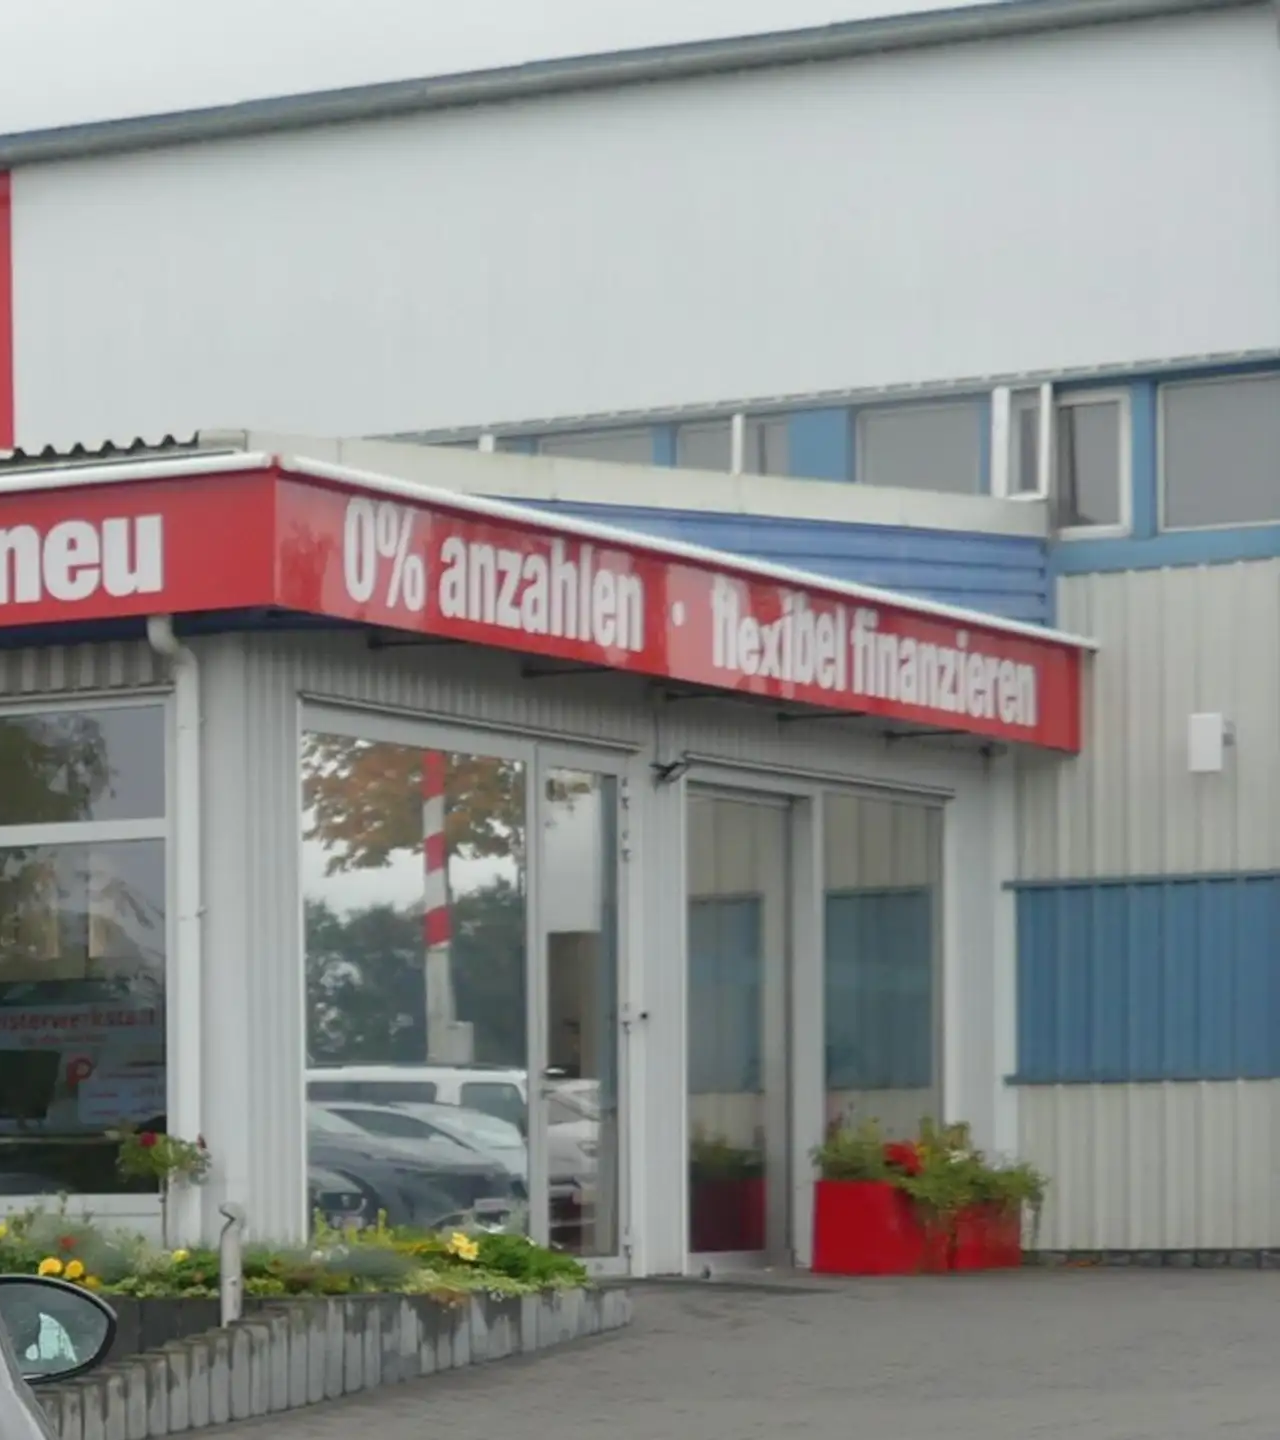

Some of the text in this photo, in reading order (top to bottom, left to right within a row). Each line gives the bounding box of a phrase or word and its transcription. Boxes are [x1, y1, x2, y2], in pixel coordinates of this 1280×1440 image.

[343, 496, 1037, 727] 0% anzahlen flexibel finanzieren
